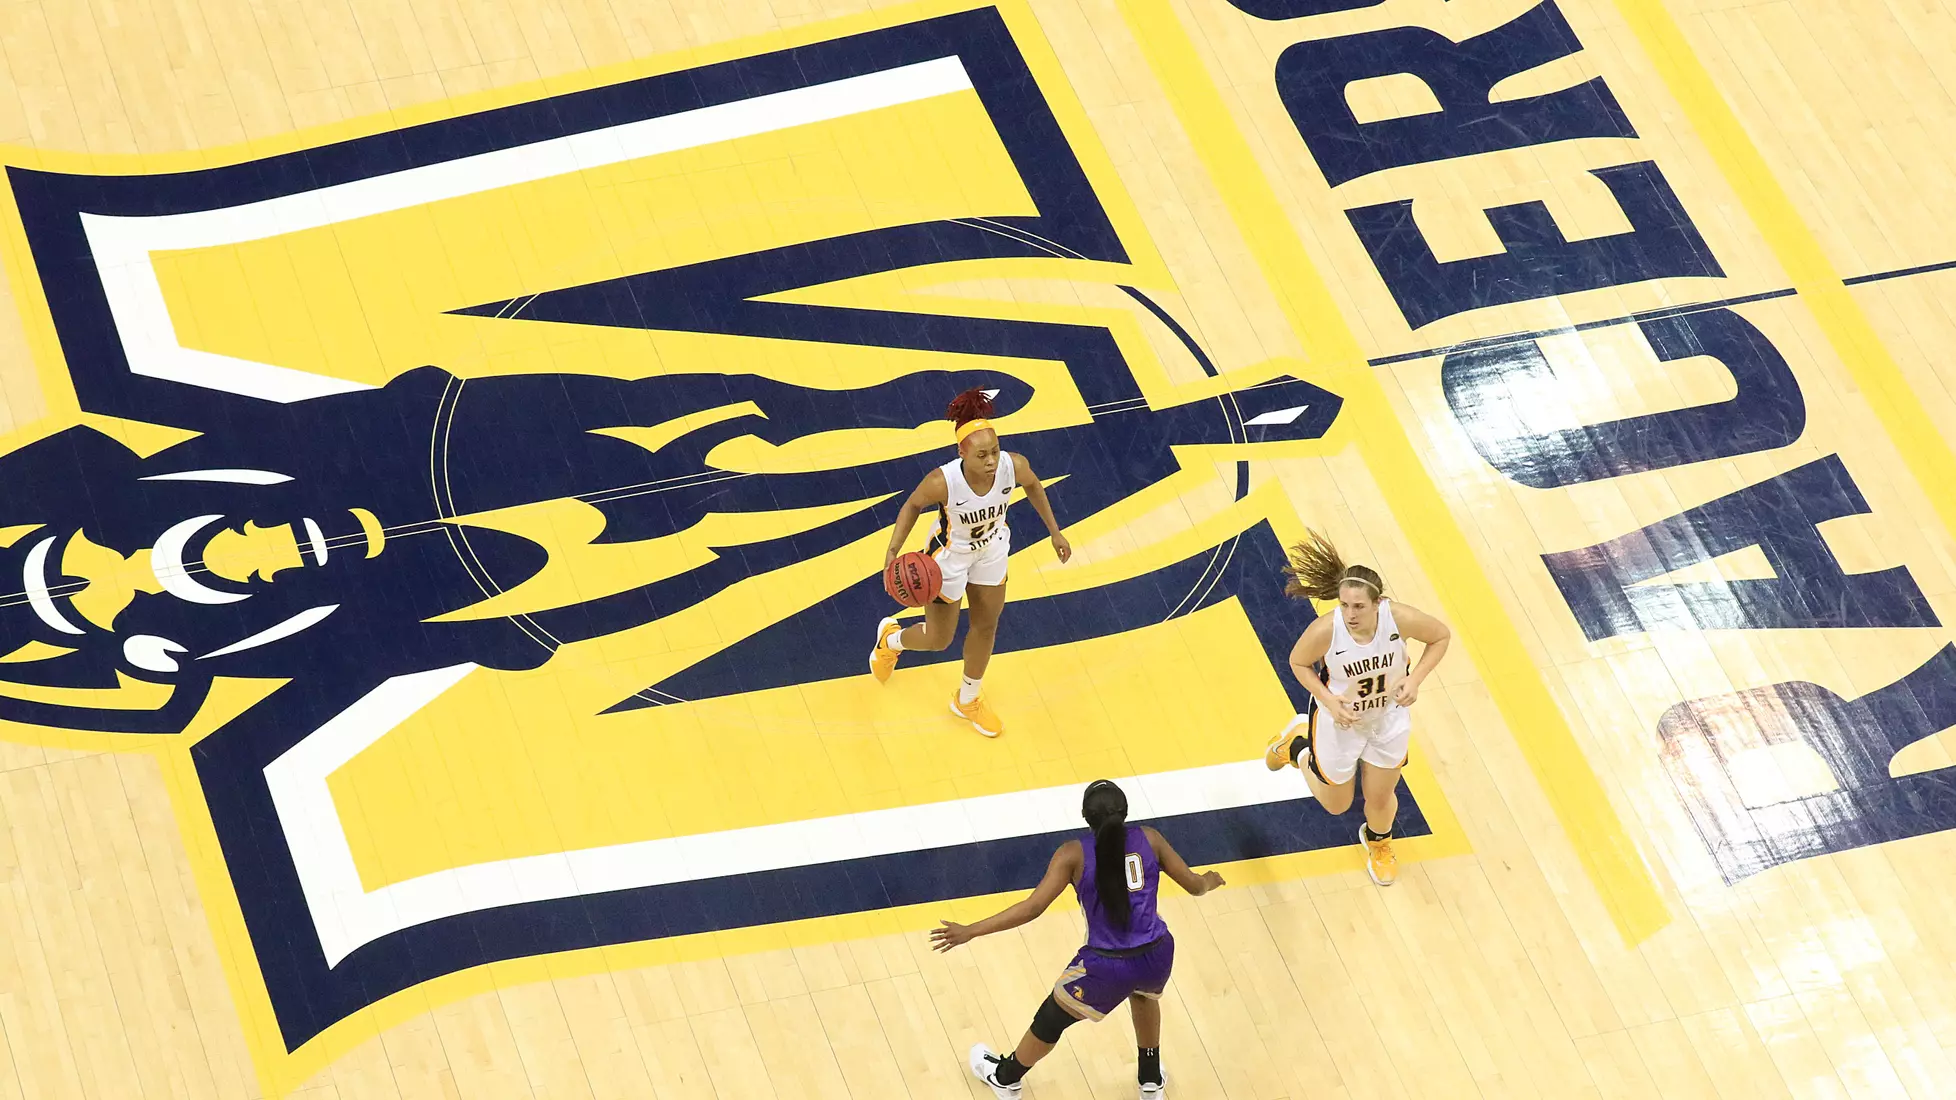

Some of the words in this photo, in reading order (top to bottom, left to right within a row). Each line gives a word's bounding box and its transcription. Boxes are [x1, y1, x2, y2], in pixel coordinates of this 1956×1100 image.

[894, 562, 909, 600] Wilson
[907, 562, 922, 590] NCAA
[1342, 651, 1395, 678] MURRAY
[1357, 673, 1387, 699] 31
[1353, 695, 1388, 712] STATE
[1124, 852, 1145, 892] 0
